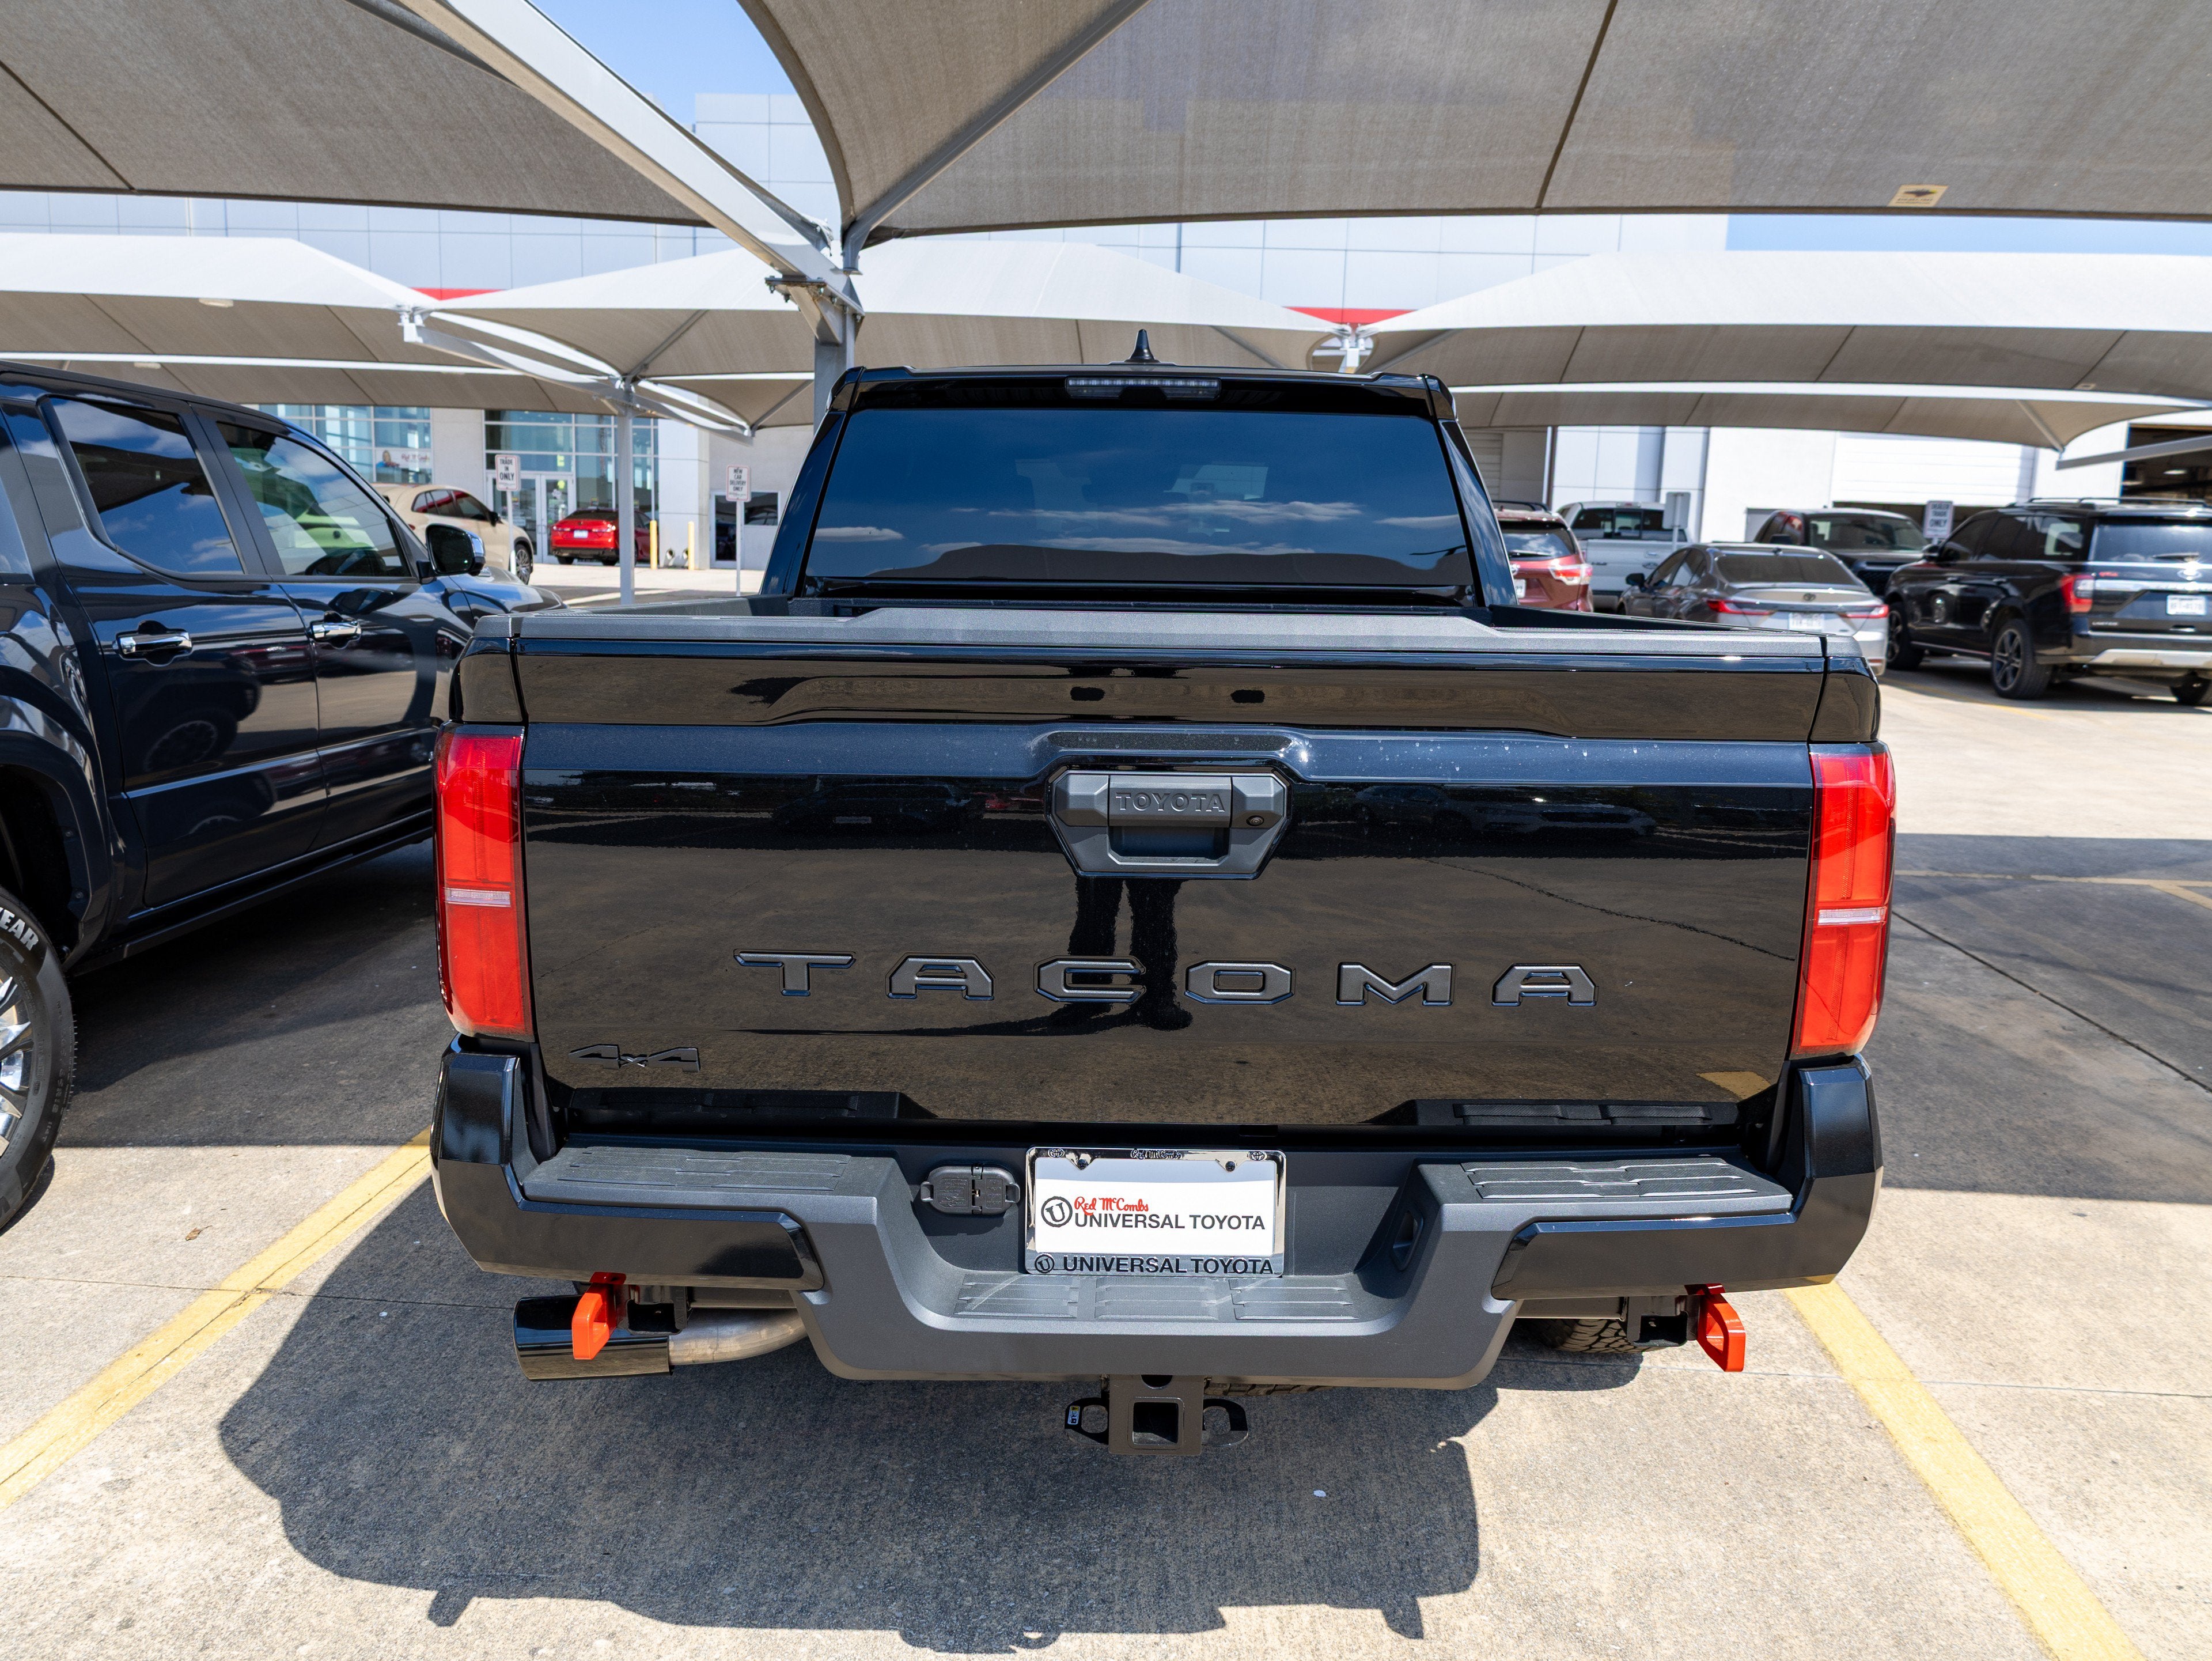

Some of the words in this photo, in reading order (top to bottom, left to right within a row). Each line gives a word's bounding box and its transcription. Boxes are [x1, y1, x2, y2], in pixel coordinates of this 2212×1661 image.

[499, 472, 514, 480] ONLY
[1930, 519, 1947, 527] ONLY
[1116, 792, 1225, 812] TOYOTA
[0, 906, 39, 951] EAR
[733, 949, 1597, 1007] TACOMA
[1074, 1196, 1097, 1216] Red
[1099, 1198, 1149, 1212] McCombs
[1075, 1213, 1185, 1229] UNIVERSAL
[1189, 1214, 1265, 1229] TOYOTA
[1063, 1255, 1187, 1273] UNIVERSAL
[1191, 1257, 1273, 1274] TOYOTA
